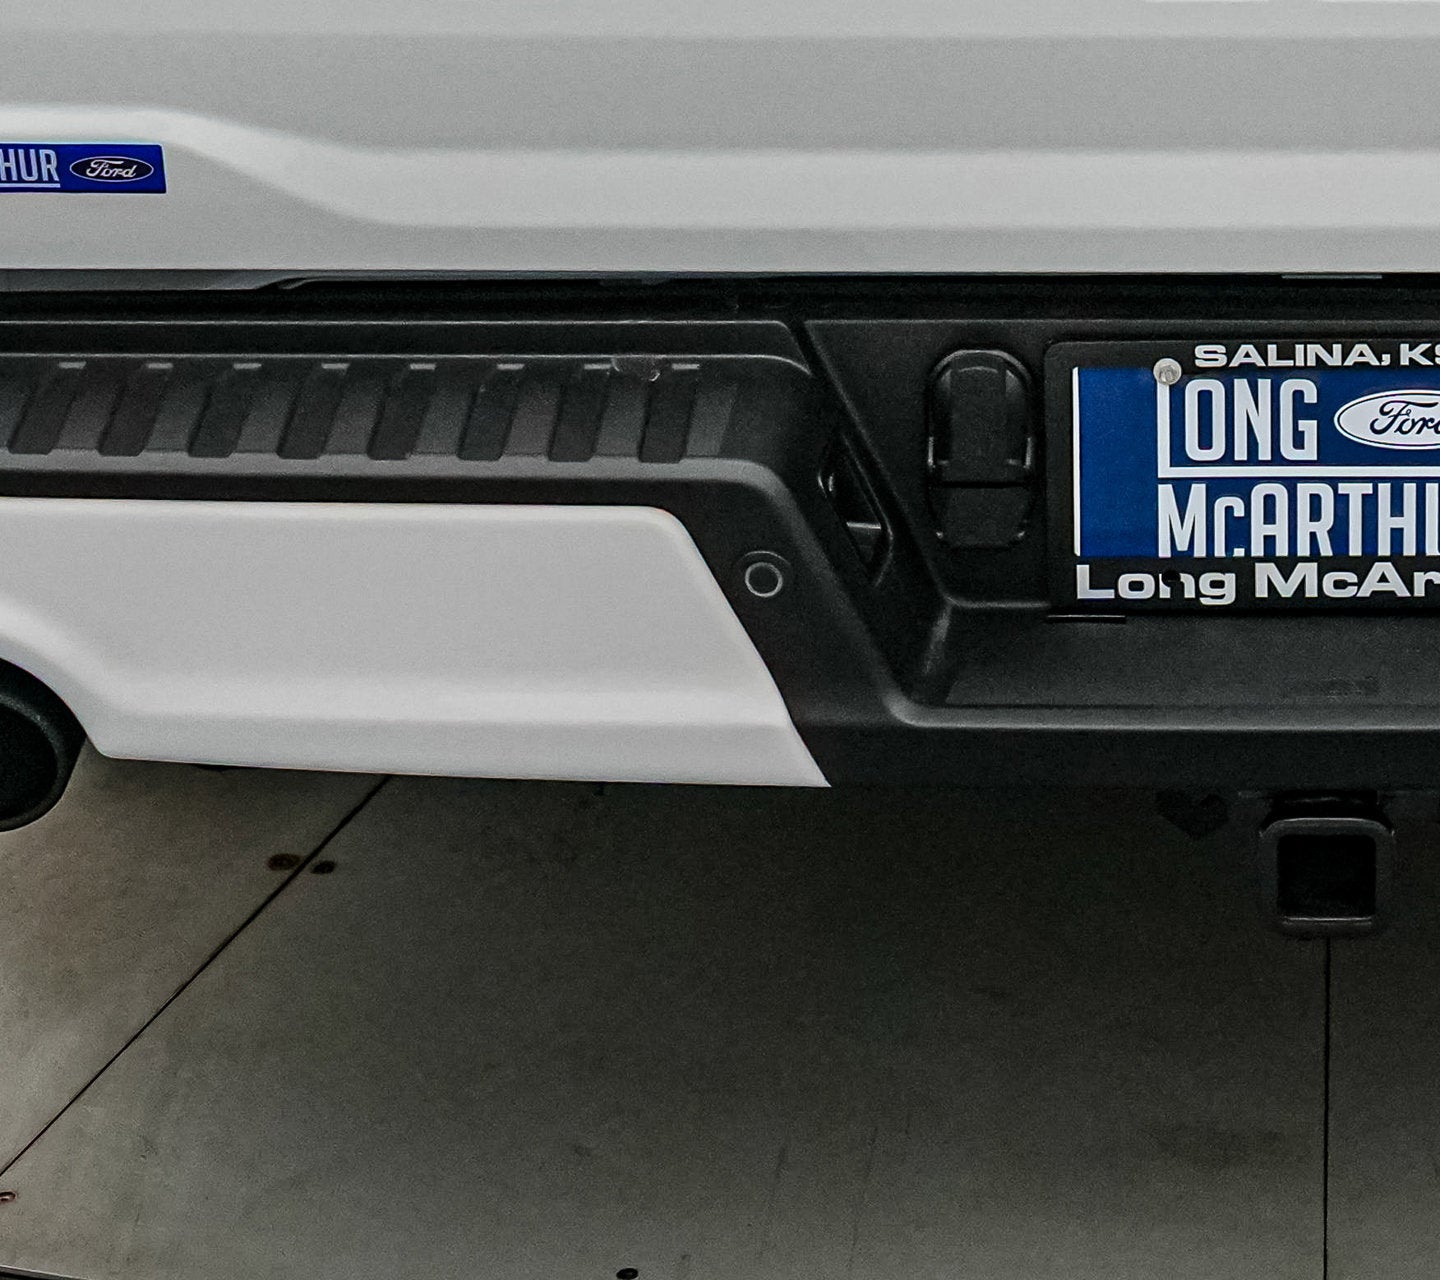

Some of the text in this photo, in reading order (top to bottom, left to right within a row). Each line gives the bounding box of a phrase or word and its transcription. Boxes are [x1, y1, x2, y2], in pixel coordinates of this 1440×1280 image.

[84, 158, 137, 179] Ford
[1158, 378, 1319, 478] LONG
[1076, 564, 1236, 606] Long
